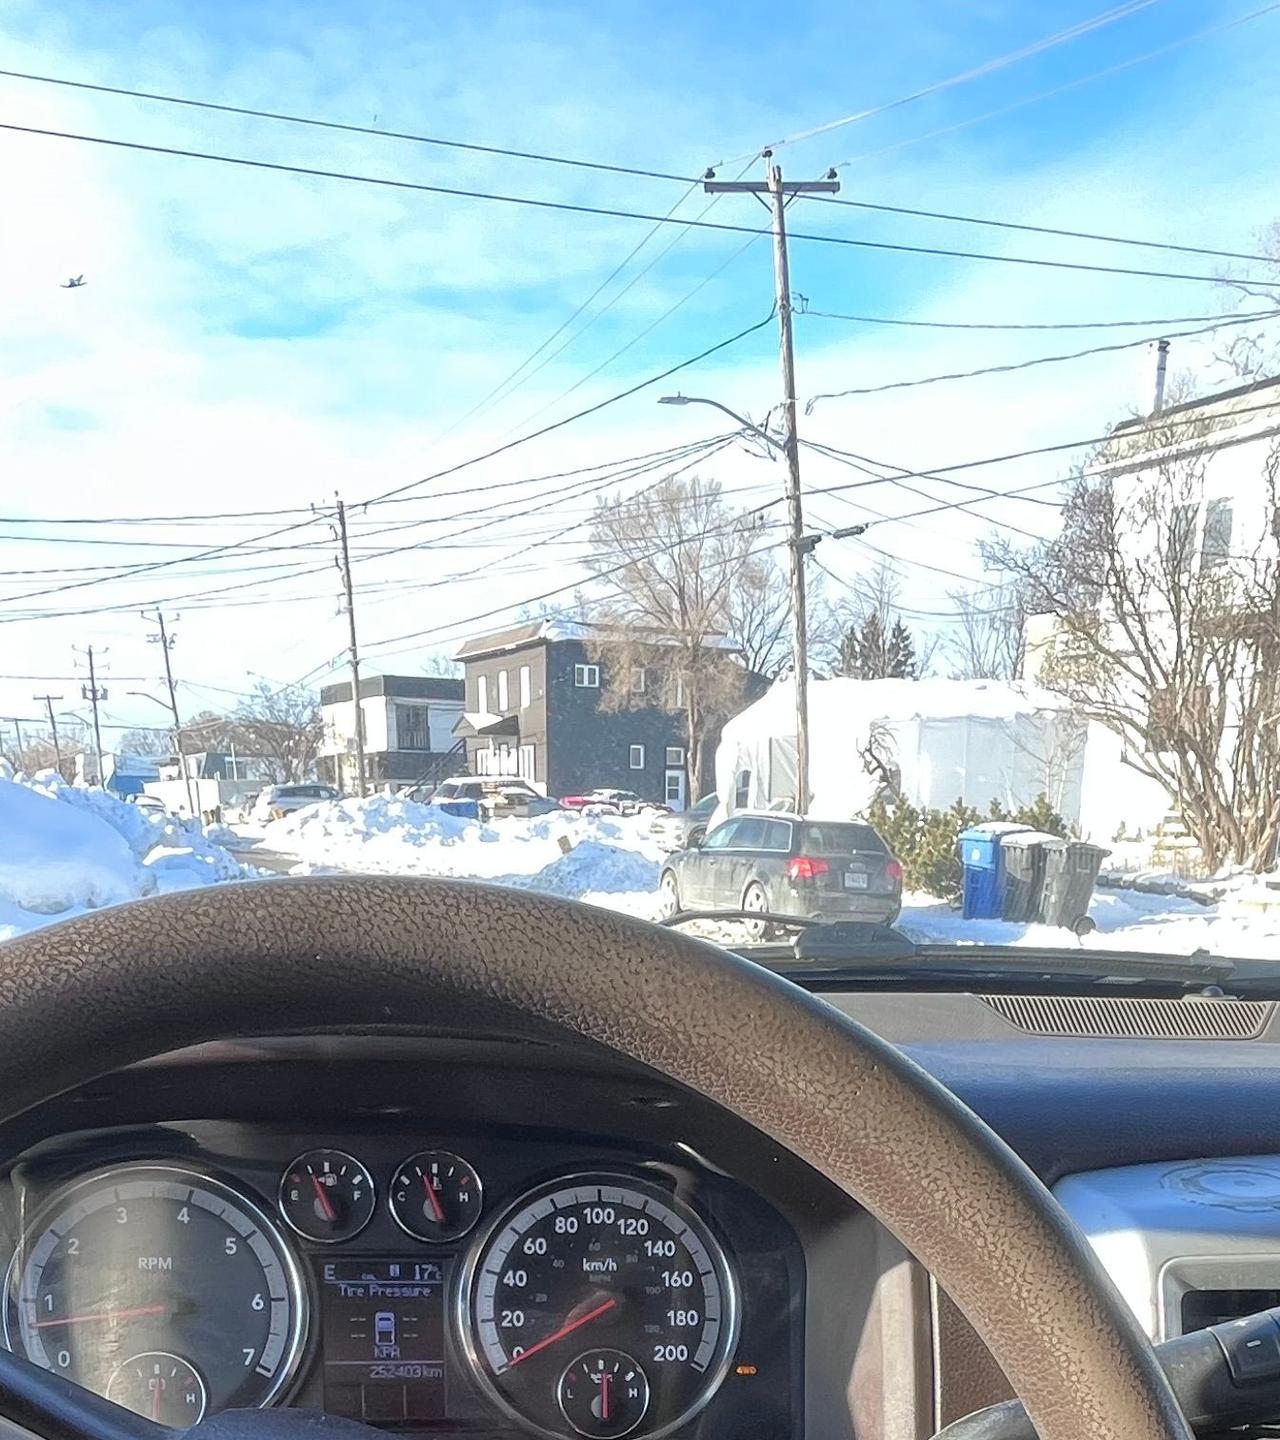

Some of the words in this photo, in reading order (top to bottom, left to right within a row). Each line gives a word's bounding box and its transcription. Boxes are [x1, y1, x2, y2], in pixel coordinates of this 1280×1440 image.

[290, 1191, 298, 1200] E
[353, 1192, 361, 1201] F
[397, 1192, 406, 1201] C
[459, 1193, 468, 1202] H
[116, 1207, 128, 1224] 3
[176, 1207, 190, 1224] 4
[583, 1208, 614, 1224] 100
[555, 1217, 578, 1234] 80
[617, 1219, 649, 1235] 120
[68, 1238, 80, 1255] 2
[225, 1238, 237, 1255] 5
[523, 1238, 547, 1255] 60
[644, 1240, 676, 1257] 140
[138, 1257, 172, 1270] RPM
[582, 1258, 617, 1272] km/h
[324, 1265, 336, 1280] E
[503, 1270, 527, 1287] 40
[661, 1271, 693, 1287] 160
[339, 1285, 364, 1297] Tire
[370, 1285, 431, 1297] Pressure
[44, 1295, 53, 1311] 1
[252, 1294, 264, 1310] 6
[501, 1311, 524, 1327] 20
[667, 1310, 698, 1326] 180
[58, 1350, 70, 1367] 0
[243, 1349, 255, 1366] 7
[654, 1345, 688, 1361] 200
[185, 1393, 196, 1403] H
[567, 1389, 573, 1398] L
[629, 1388, 638, 1398] H
